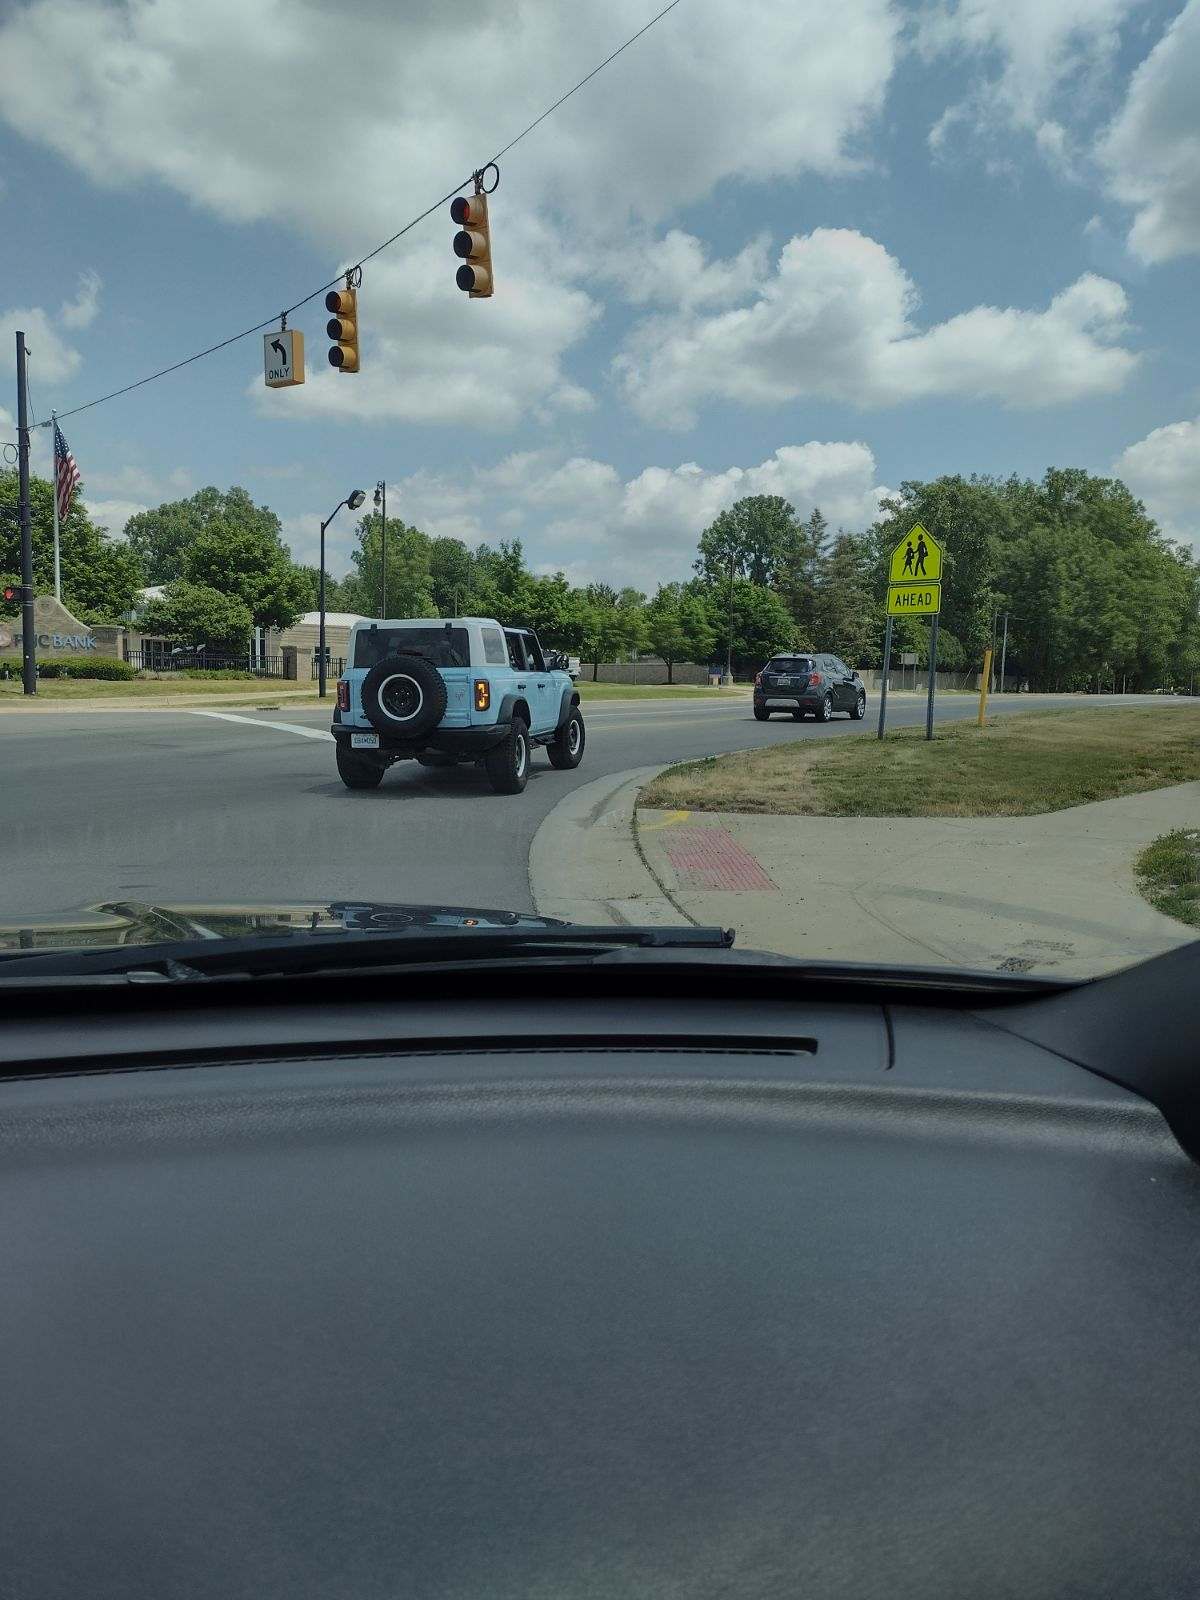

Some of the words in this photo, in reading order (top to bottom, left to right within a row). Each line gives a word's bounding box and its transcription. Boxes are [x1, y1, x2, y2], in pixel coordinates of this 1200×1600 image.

[269, 367, 290, 380] ONLY
[895, 592, 932, 606] AHEAD
[12, 633, 50, 648] PC
[52, 634, 97, 650] BANK
